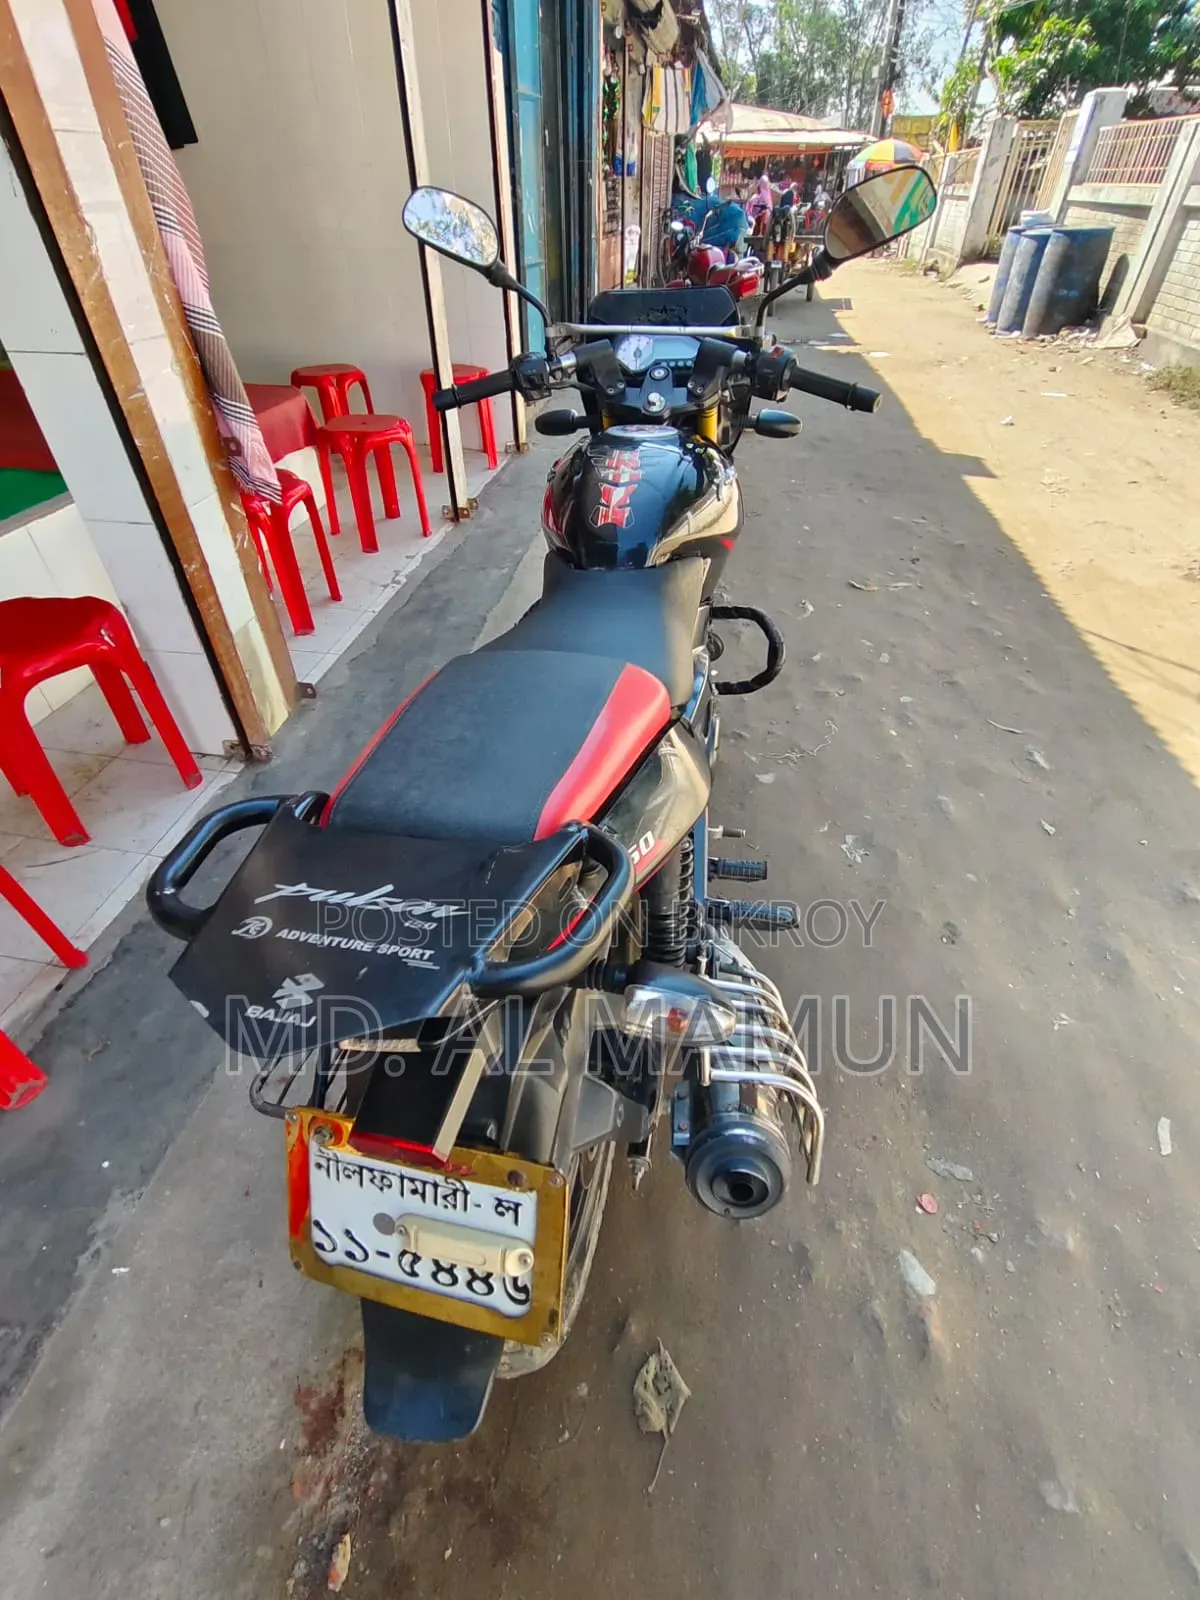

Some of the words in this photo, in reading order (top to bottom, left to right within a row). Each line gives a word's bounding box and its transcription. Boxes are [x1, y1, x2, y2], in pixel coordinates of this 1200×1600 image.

[276, 928, 376, 953] ADVENTURE
[376, 942, 435, 962] SPORT
[244, 1005, 317, 1028] BAJAJ
